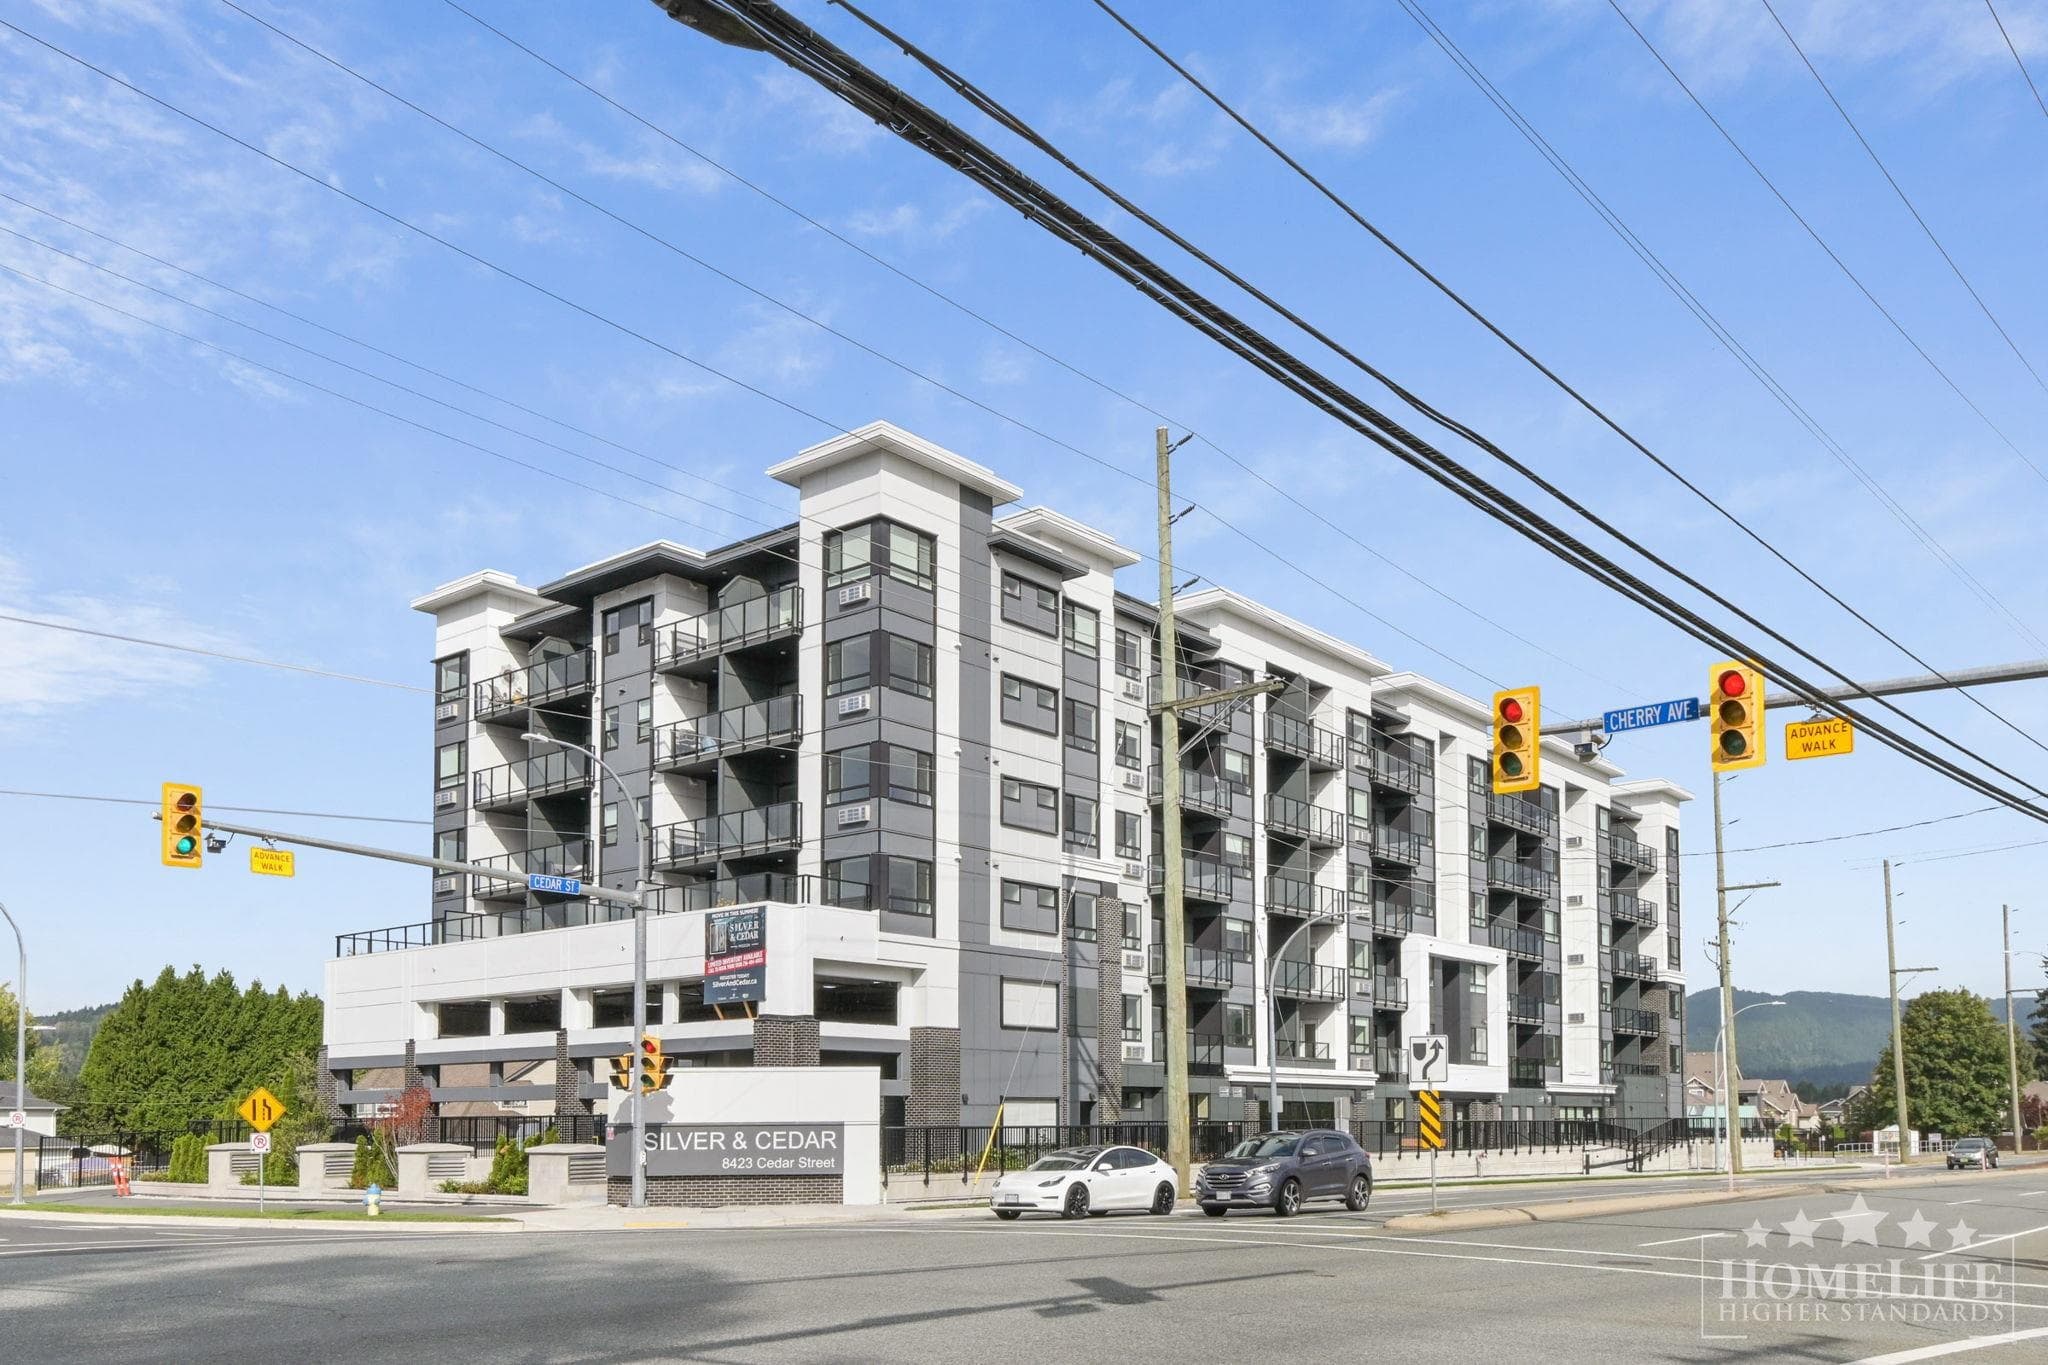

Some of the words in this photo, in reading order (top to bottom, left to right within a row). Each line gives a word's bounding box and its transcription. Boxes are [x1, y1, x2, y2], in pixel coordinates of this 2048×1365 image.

[1610, 705, 1662, 731] CHERRY
[1667, 700, 1693, 722] AVE
[1790, 721, 1848, 740] ADVANCE
[1802, 739, 1837, 752] WALK
[253, 851, 291, 863] ADVANCE
[261, 862, 284, 872] WALK
[534, 876, 562, 890] CEDAR
[565, 880, 576, 892] ST
[730, 920, 759, 931] SILVER
[730, 933, 736, 941] &
[736, 930, 759, 940] CEDAR
[644, 1131, 726, 1151] SILVER
[732, 1131, 748, 1150] &
[755, 1130, 837, 1150] CEDAR
[722, 1157, 753, 1169] 8423
[756, 1156, 795, 1169] Cedar
[798, 1156, 835, 1168] Street
